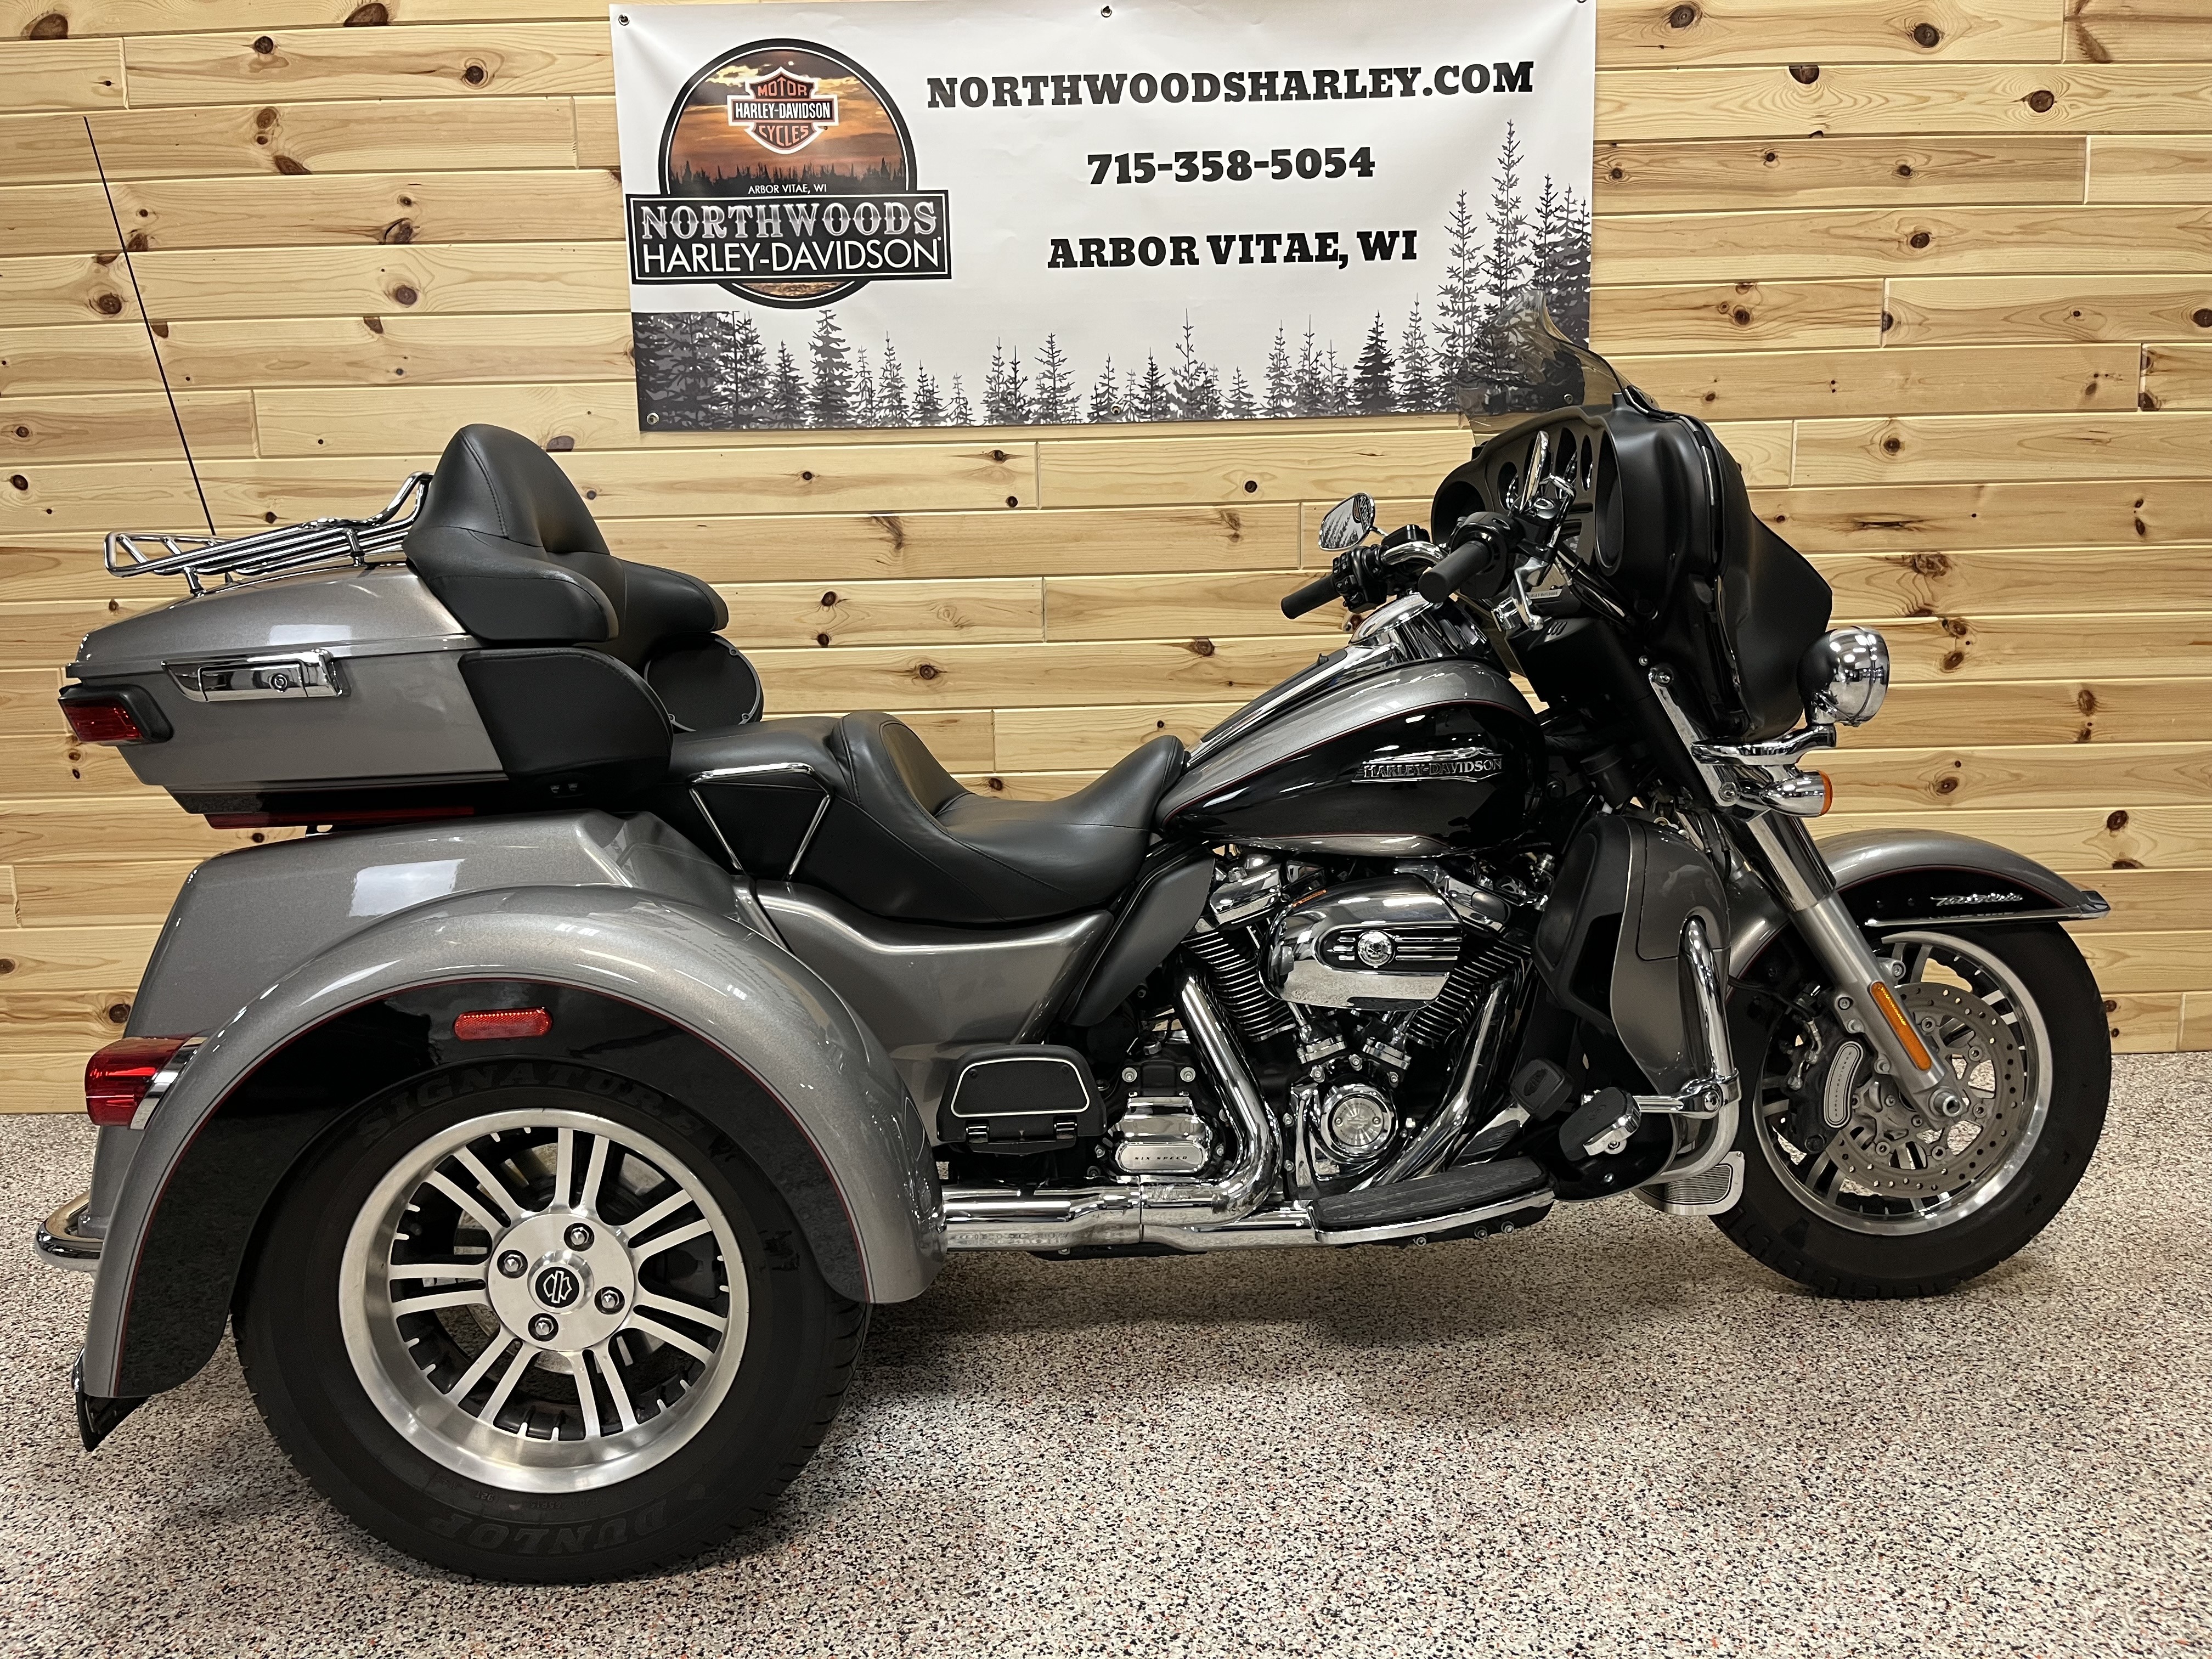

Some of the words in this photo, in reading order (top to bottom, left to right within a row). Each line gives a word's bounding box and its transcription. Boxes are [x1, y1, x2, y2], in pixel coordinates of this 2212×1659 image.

[758, 76, 807, 97] MOTOR
[927, 61, 1534, 108] NORTHWOODSHARLEY.COM
[735, 102, 831, 119] HARLEY-DAVIDSON
[759, 125, 809, 146] CYCLES
[1087, 146, 1375, 185] 715-358-5054
[748, 185, 780, 194] ARBOR
[782, 184, 811, 194] VITAE,
[813, 184, 827, 193] WI
[640, 201, 937, 240] NORTHWOODS
[642, 237, 939, 273] HARLEY-DAVIDSON
[1047, 235, 1199, 269] ARBOR
[1206, 232, 1348, 270] VITAE,
[1356, 230, 1417, 261] WI
[1363, 758, 1503, 778] HARLEY-DAVIDSON
[424, 1498, 667, 1555] DUNLOP
